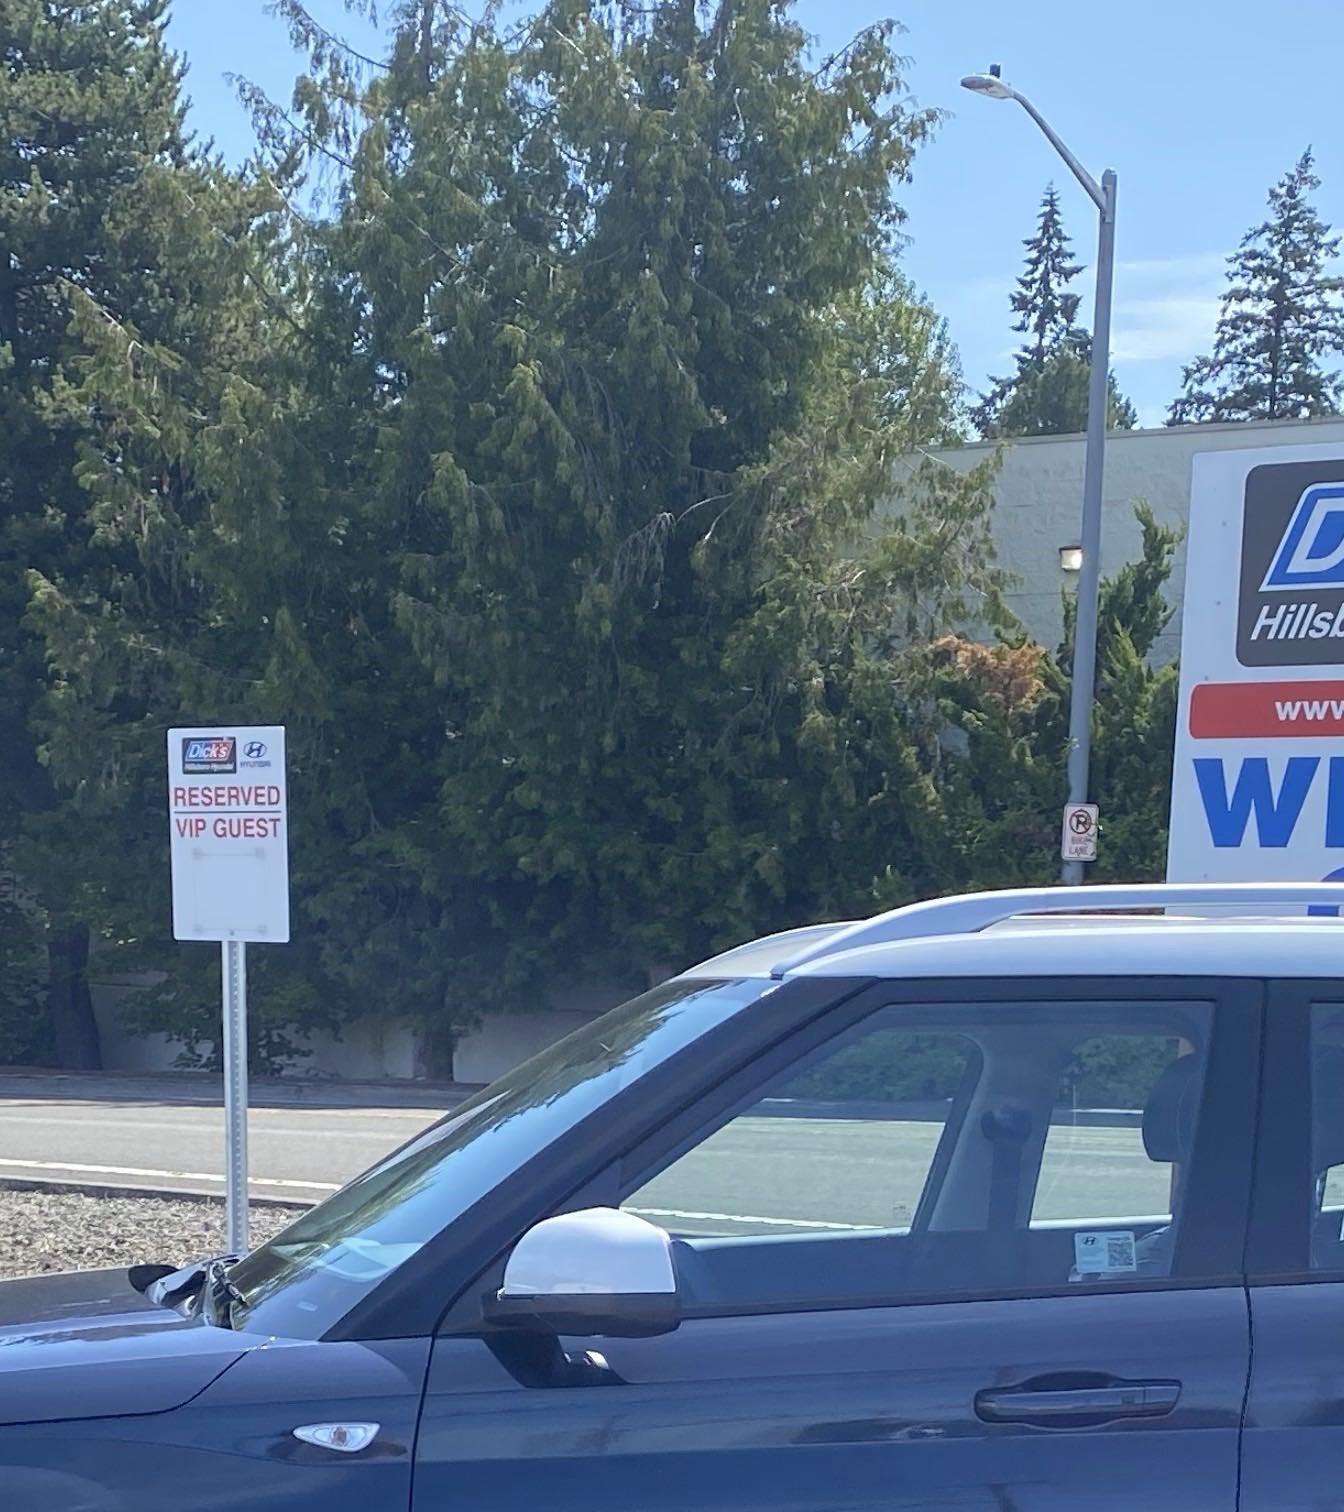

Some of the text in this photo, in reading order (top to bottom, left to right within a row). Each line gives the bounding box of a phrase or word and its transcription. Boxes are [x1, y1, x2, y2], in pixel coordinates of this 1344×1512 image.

[189, 743, 228, 758] Dick's
[174, 786, 280, 807] RESERVED
[176, 817, 281, 838] VIP GUEST
